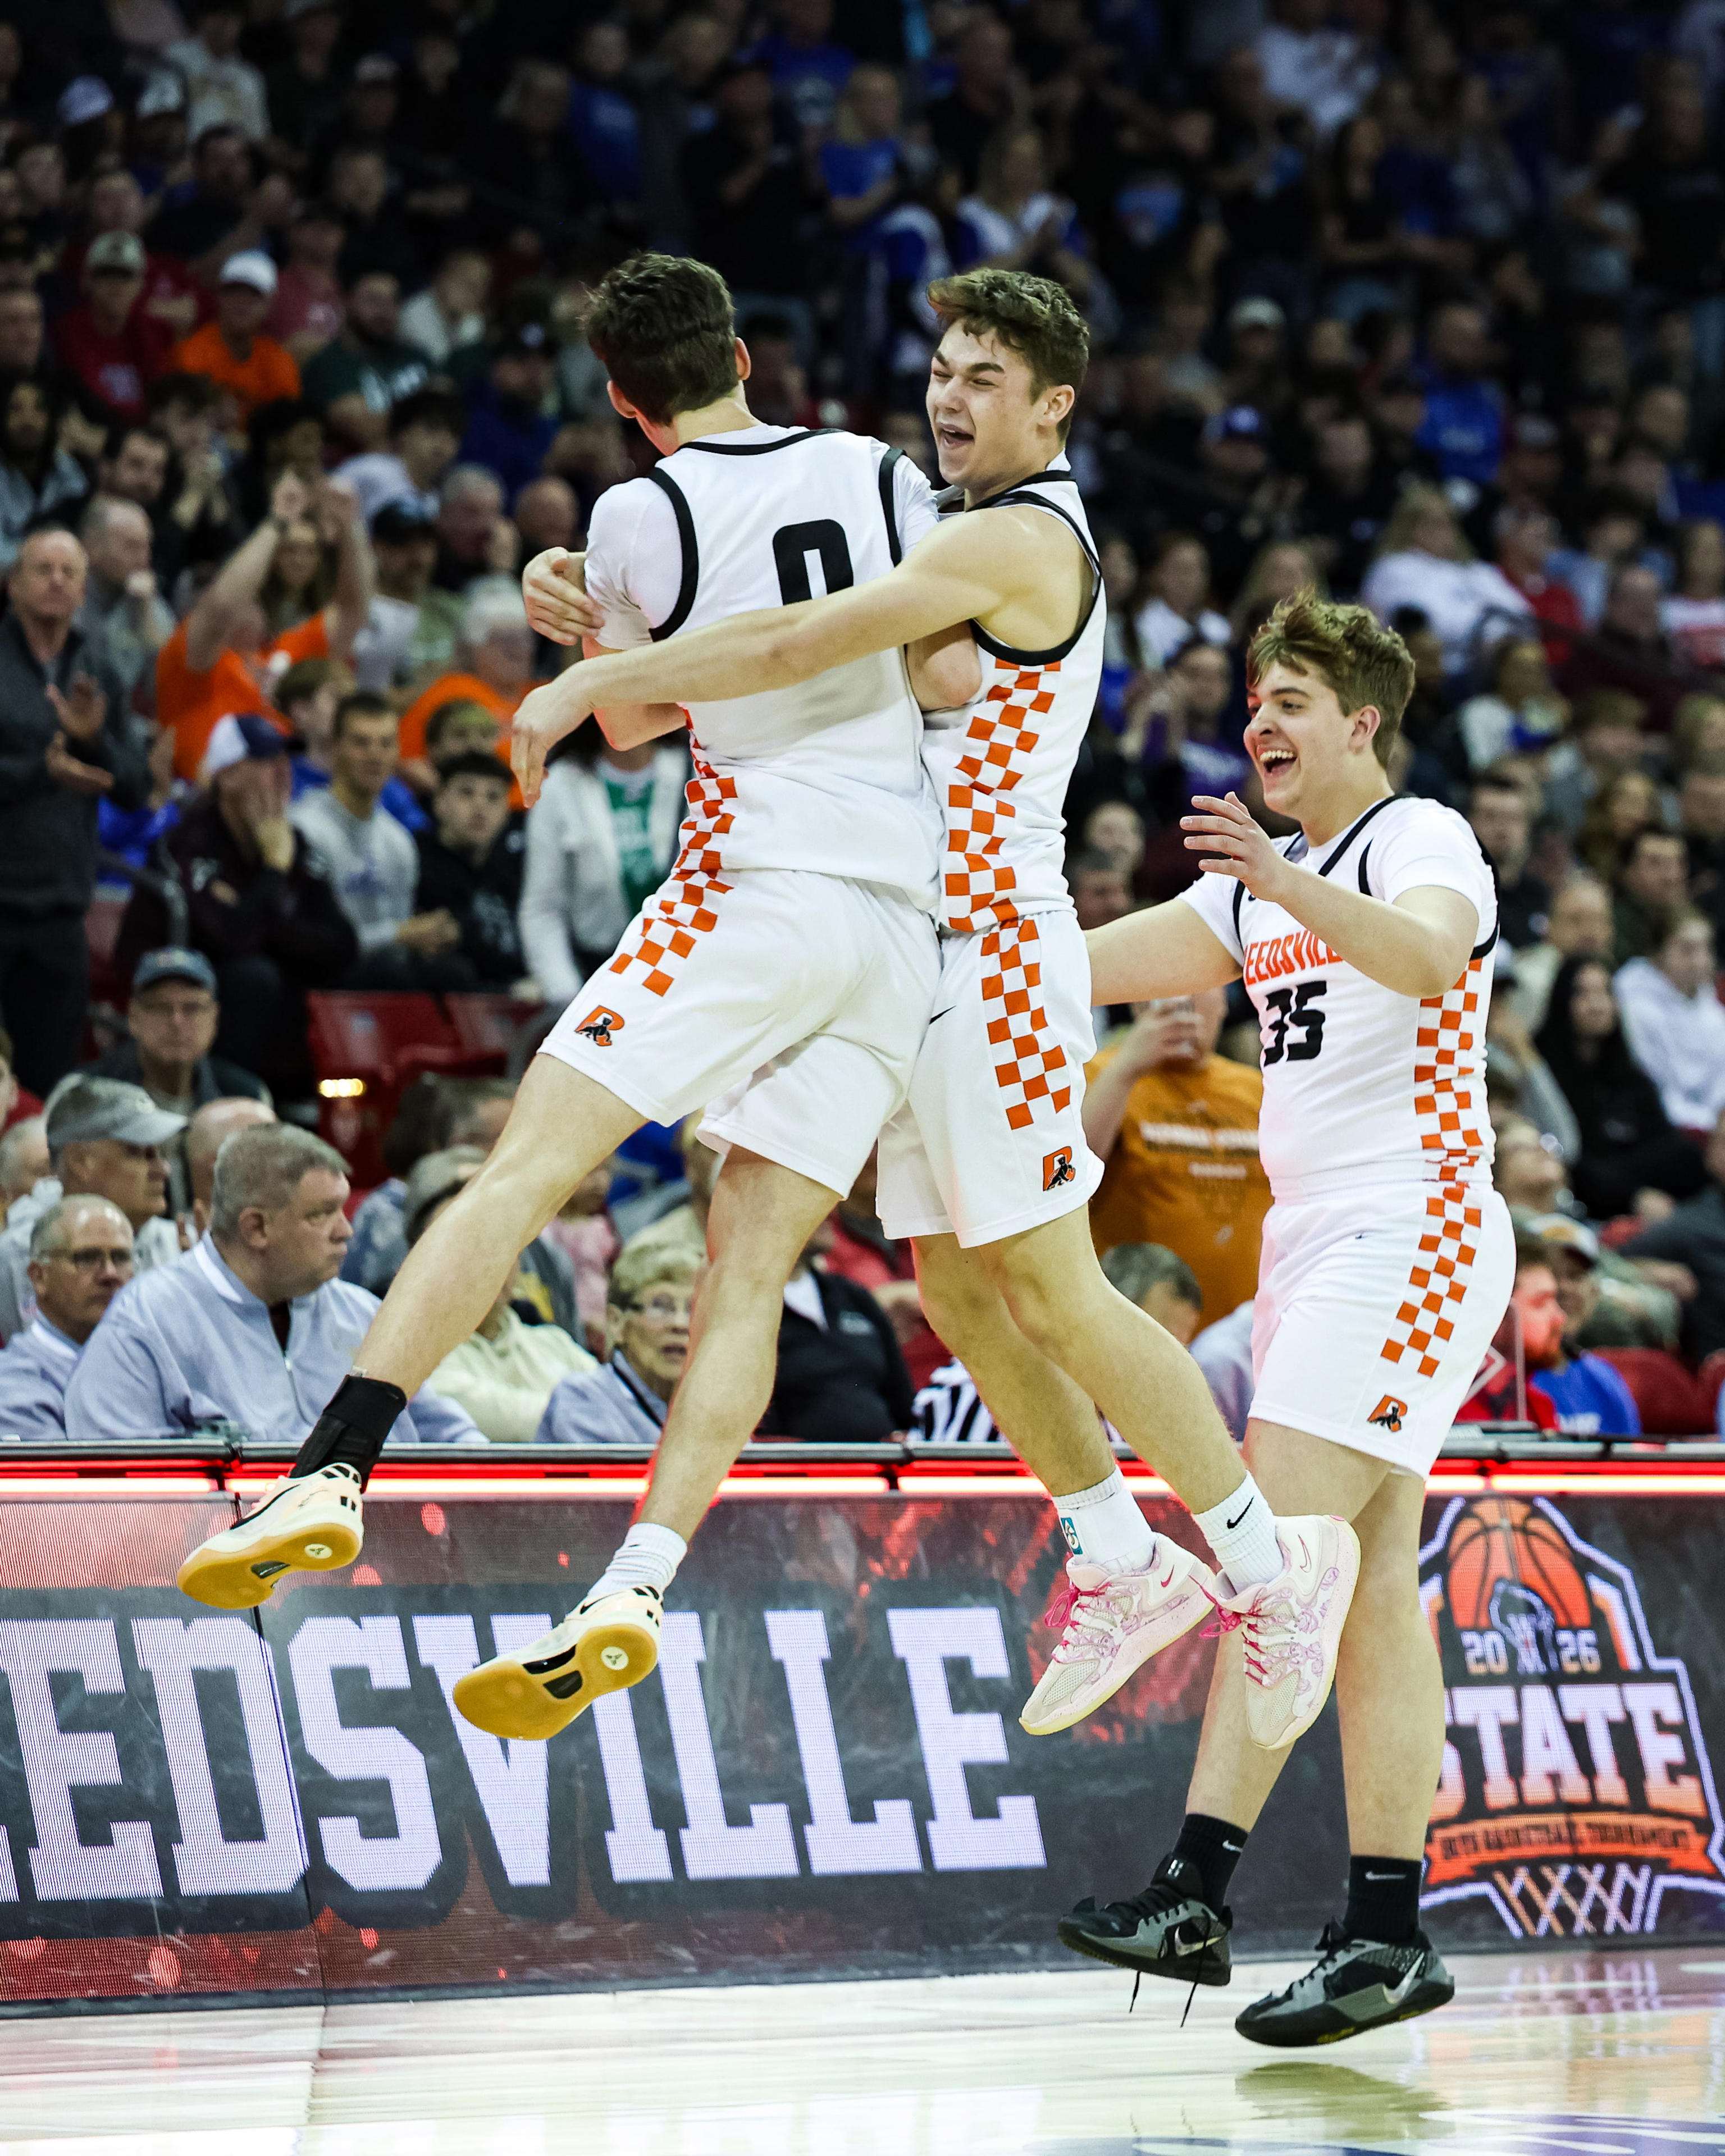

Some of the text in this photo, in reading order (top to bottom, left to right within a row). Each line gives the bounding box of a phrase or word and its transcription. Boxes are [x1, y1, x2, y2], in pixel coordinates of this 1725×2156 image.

[773, 519, 854, 606] 0
[1244, 929, 1344, 986] EEDSVILL
[1263, 980, 1327, 1067] 35
[1460, 1628, 1601, 1674] 20 26
[0, 1607, 1048, 1902] EDSVILLE
